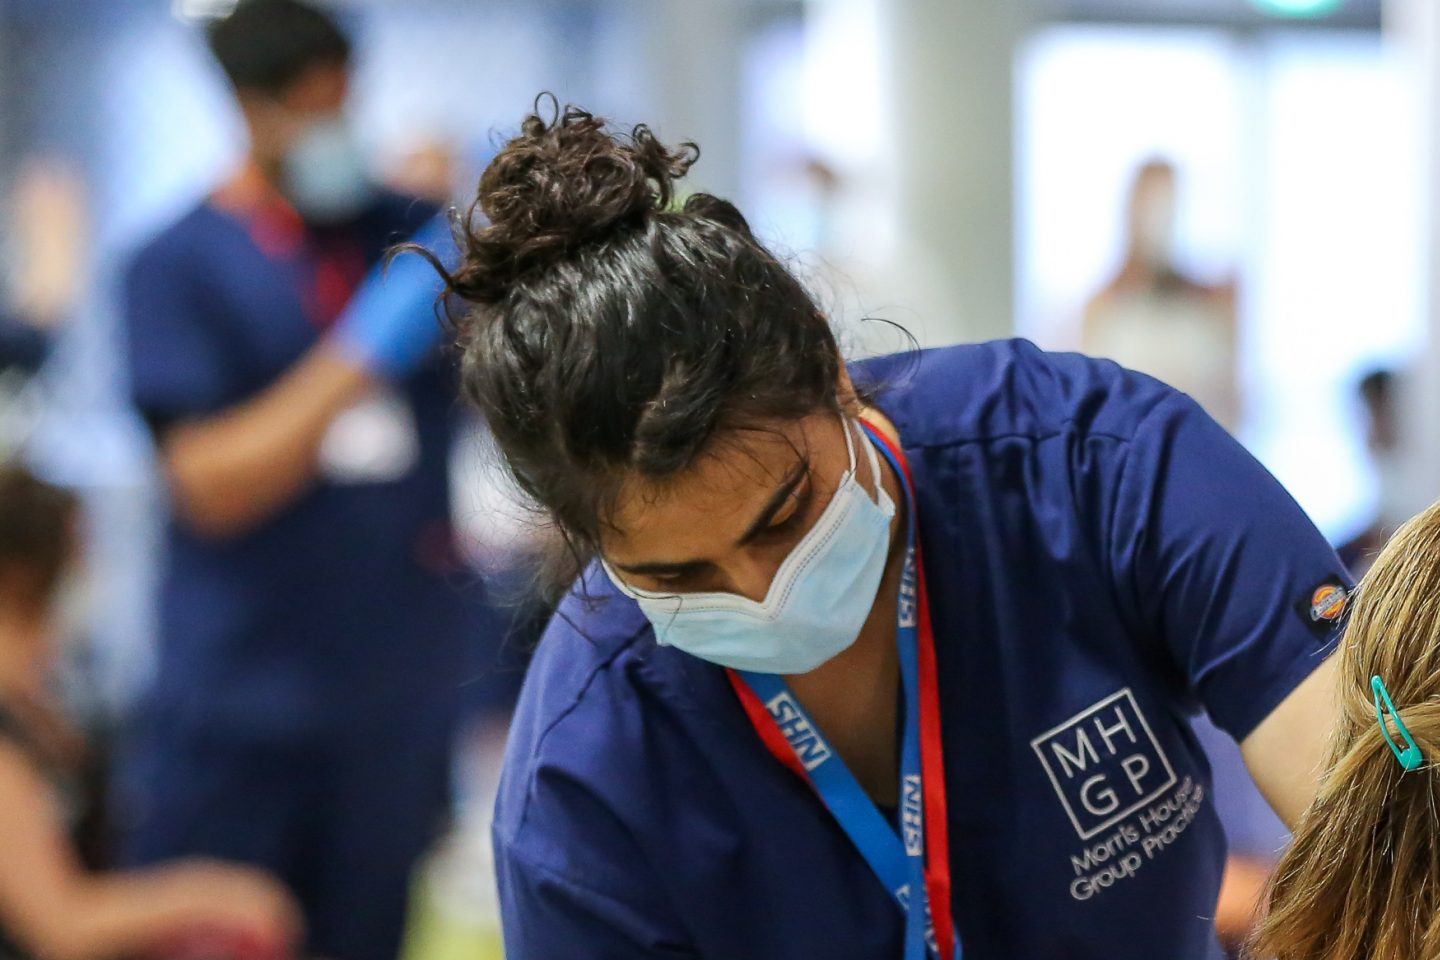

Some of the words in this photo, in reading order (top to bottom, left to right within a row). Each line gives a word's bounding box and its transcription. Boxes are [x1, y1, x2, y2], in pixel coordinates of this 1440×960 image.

[767, 698, 829, 766] NHS
[1050, 706, 1136, 778] MH
[904, 778, 922, 855] NHS
[1079, 753, 1151, 816] GP
[1070, 824, 1140, 876] Morris
[1138, 776, 1193, 833] House
[1070, 852, 1142, 901] Group
[1142, 783, 1204, 859] Practice
